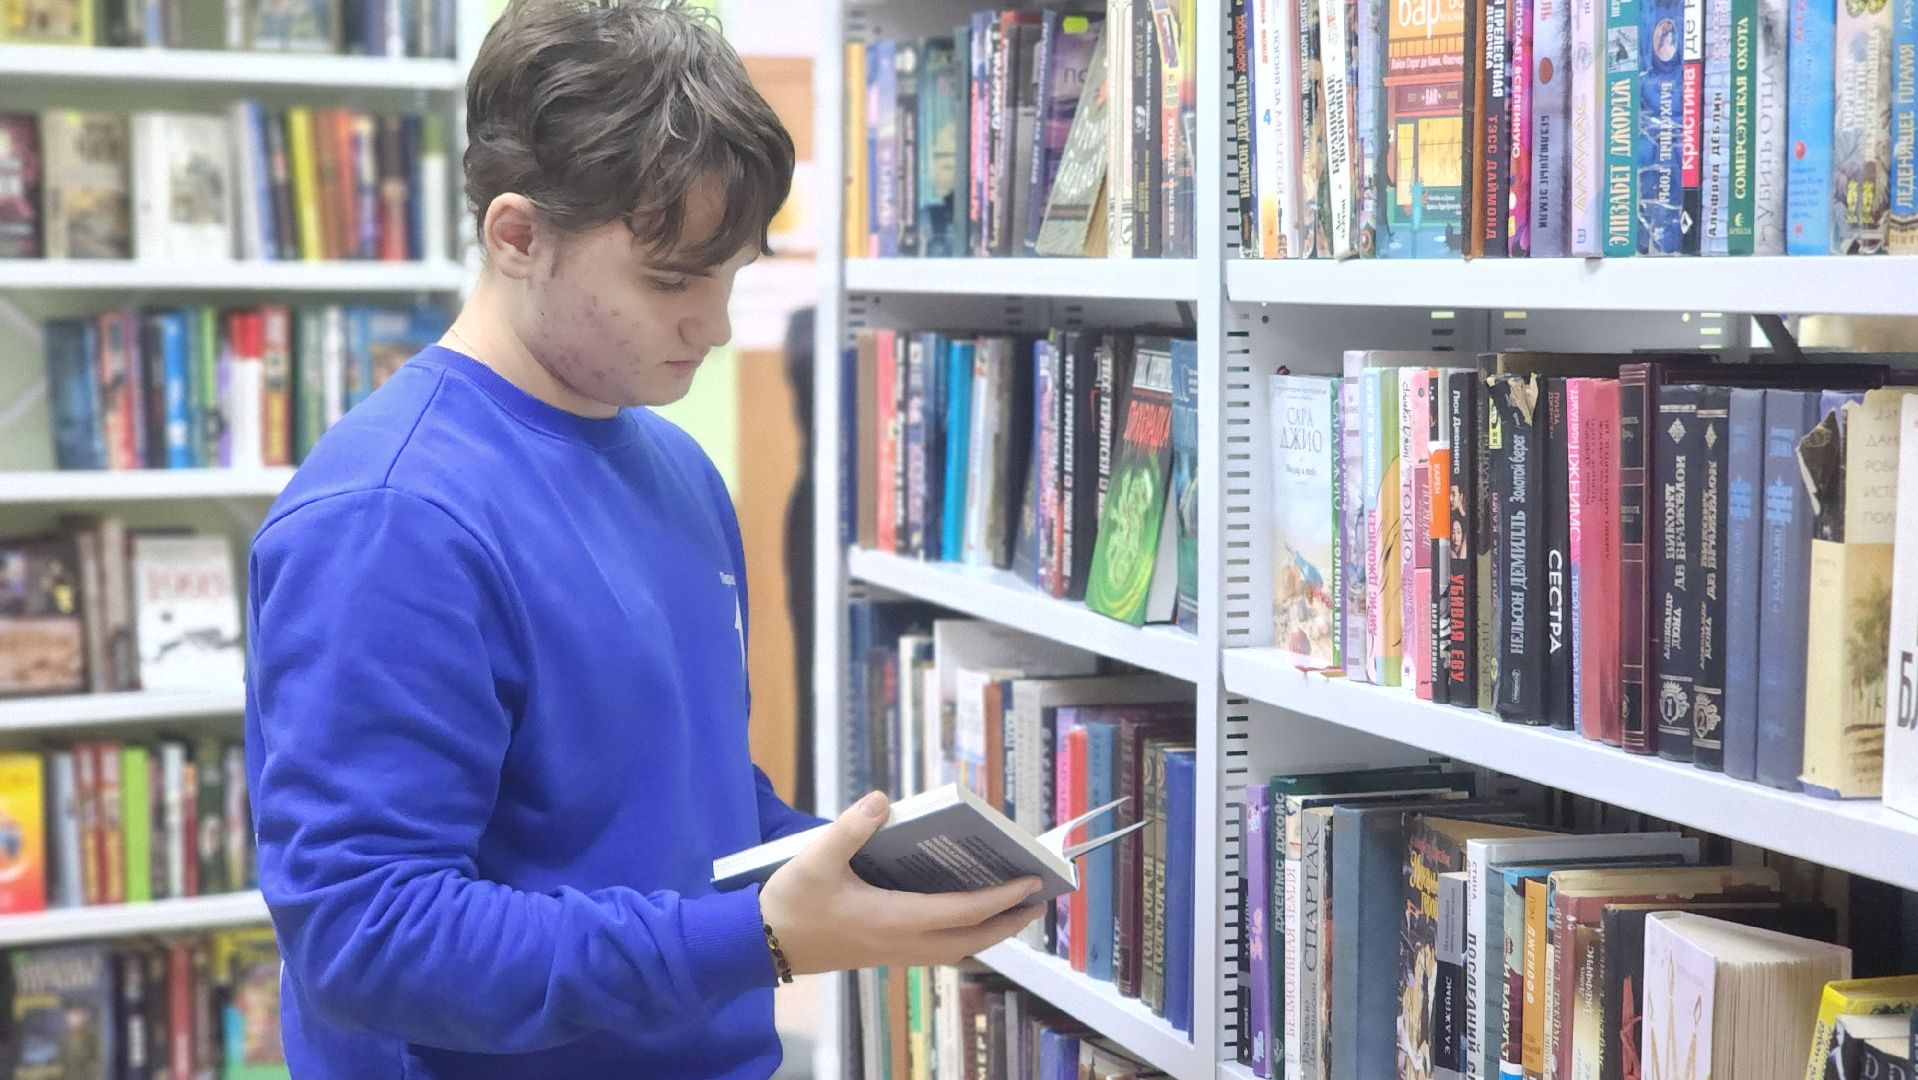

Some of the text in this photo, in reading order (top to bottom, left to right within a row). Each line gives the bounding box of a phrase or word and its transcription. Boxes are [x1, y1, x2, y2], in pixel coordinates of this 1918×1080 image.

[1485, 5, 1493, 69] ДЕВОЧКА
[1492, 9, 1504, 97] ПРЕЛЕСТНАЯ
[1898, 44, 1914, 104] ПЛАМЯ
[1236, 76, 1250, 198] НЕЛЬСОН ДЕМИЛЛЬ
[1327, 73, 1340, 174] БЕРЛИНСКИЕ
[1333, 78, 1346, 163] ПОХОРОНЫ
[1511, 66, 1522, 159] ВСЕЛЕННУЮ
[1659, 82, 1673, 203] БАРХАТНЫЕ ГОРЫ
[1682, 68, 1698, 171] Кристина
[1735, 16, 1749, 199] СОМЕРСЭТСКАЯ ОХОТА
[1757, 63, 1775, 220] УБИТЬ ОТЦА
[1896, 109, 1915, 208] ЛЕДЕНЯЩЕЕ
[1486, 114, 1499, 241] ТЭСС ДАЙМОНД
[1538, 115, 1550, 229] БЕЗЛЮДНЫЕ ЗЕМЛИ
[1609, 78, 1632, 246] ЭЛИЗАБЕТ ДЖОРДЖ
[1709, 163, 1720, 236] Альфред
[1063, 353, 1074, 472] ТЕСС ГЕРРИТСЕН
[1099, 358, 1112, 475] ТЕСС ГЕРРИТСЕН
[1279, 427, 1323, 453] ДЖИО
[1287, 406, 1314, 429] САРА
[1402, 479, 1414, 562] ТОКИО
[1434, 463, 1442, 494] КАРЕН
[1567, 443, 1582, 541] ДЖЕЙМС
[1664, 483, 1675, 560] ВИКОНТ
[1675, 455, 1687, 591] ДЕ БРАЖЕЛОН
[1707, 459, 1717, 569] БРАЖЕЛОН
[1333, 537, 1342, 651] СОЛЕНЫЙ ВЕТЕР
[1367, 508, 1378, 637] АЙРИС ДЖОАНСЕН
[1508, 433, 1527, 655] НЕЛЬСОН ДЕМИЛЛЬ Золотой берег
[1451, 573, 1465, 682] УБИВАЯ ЕВУ
[1548, 549, 1563, 654] СЕСТРА
[1571, 574, 1580, 724] ТВОЙ ДЕРЗКИЙ ВЗГЛЯД
[1663, 591, 1673, 660] АЛЕКСАНДР
[1671, 607, 1682, 649] ДЮМА
[1704, 616, 1712, 660] ДЮМА
[1274, 791, 1286, 934] ДЖЕЙМС ДЖОЙС
[1303, 825, 1319, 972] СПАРТАК
[1286, 867, 1296, 1039] БЕЗМОЛВНАЯ ЗЕМЛЯ
[1467, 933, 1481, 1053] ПОСЛЕДНИЙ
[1526, 924, 1536, 1004] ДЖЕНОФФ
[1585, 944, 1595, 1022] ДЖЕФФРИС
[1501, 982, 1510, 1044] ВДРУГ
[1552, 989, 1562, 1050] ДЖЕЙМС
